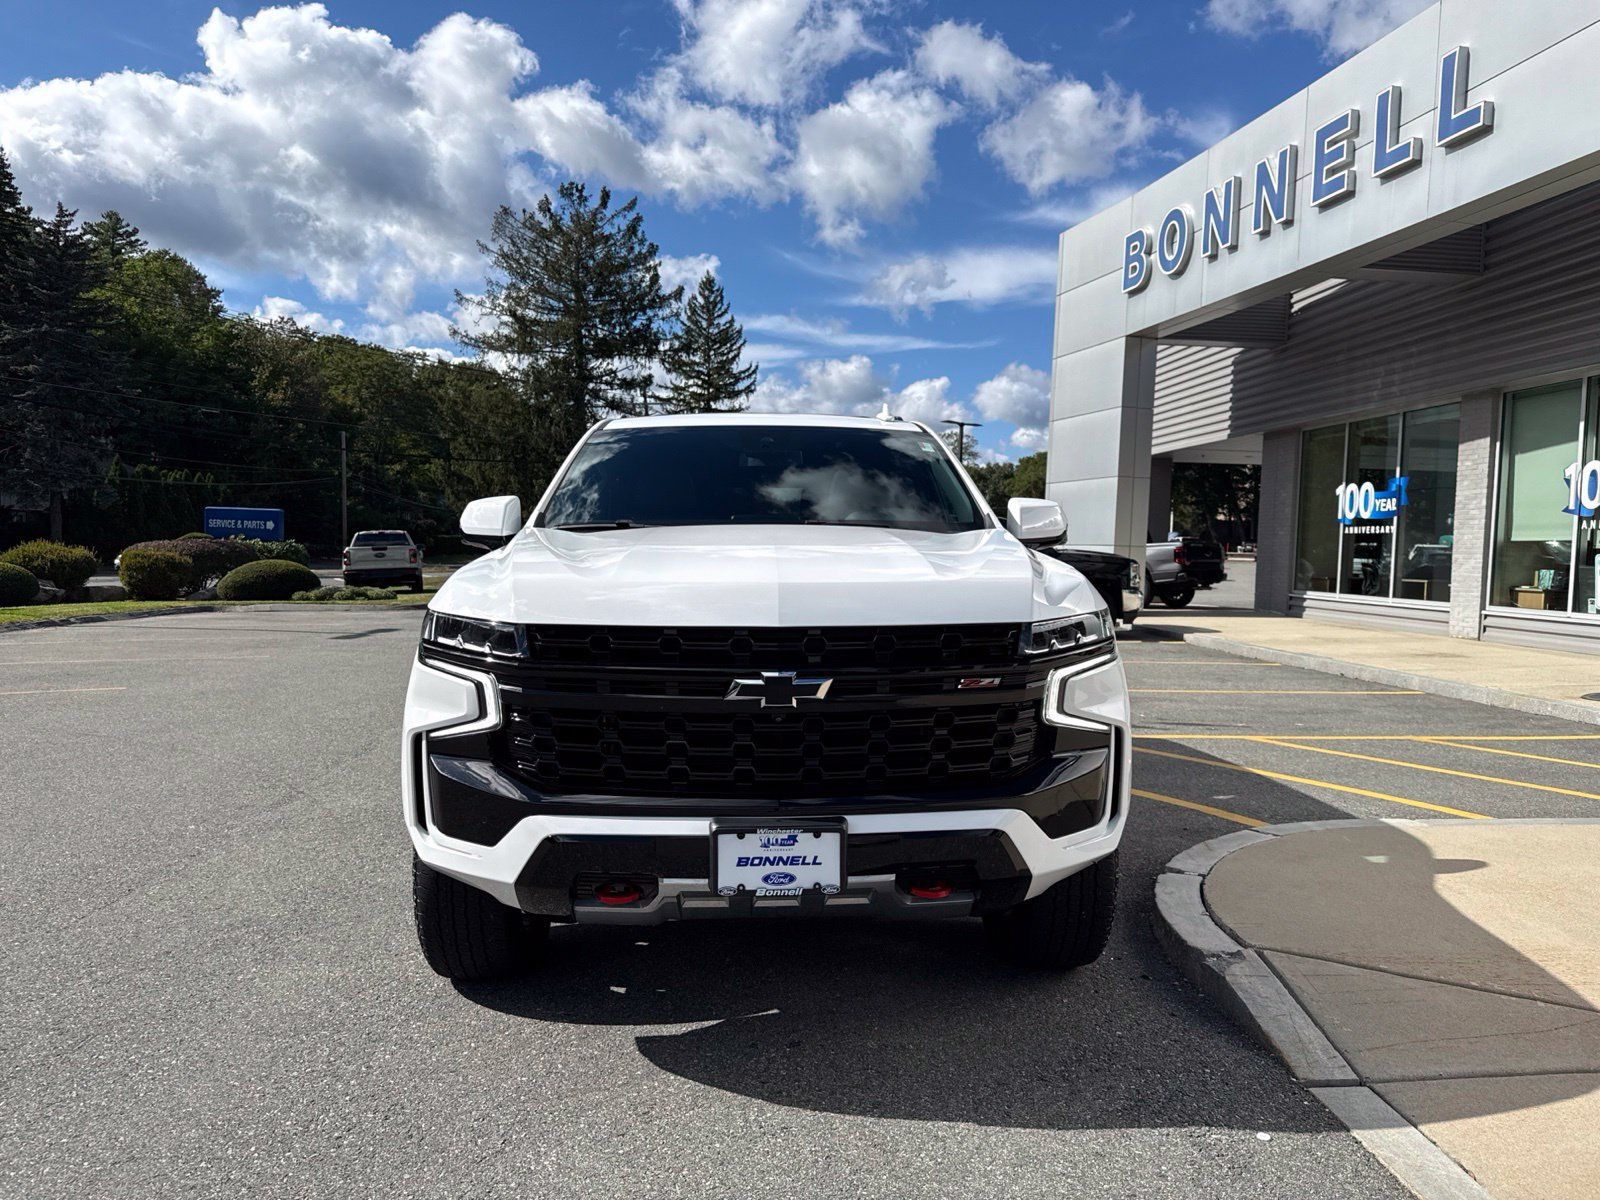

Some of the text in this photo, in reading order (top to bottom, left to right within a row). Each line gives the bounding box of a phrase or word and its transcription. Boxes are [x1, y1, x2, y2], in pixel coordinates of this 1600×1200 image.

[1122, 45, 1494, 294] BONNELL
[1335, 481, 1397, 519] 100 YEAR
[208, 519, 265, 529] SERVICE & PARTS
[1344, 525, 1396, 534] ANNIVERSARY
[736, 856, 822, 867] BONNELL
[767, 874, 790, 884] Ford
[755, 887, 803, 896] Bonnell
